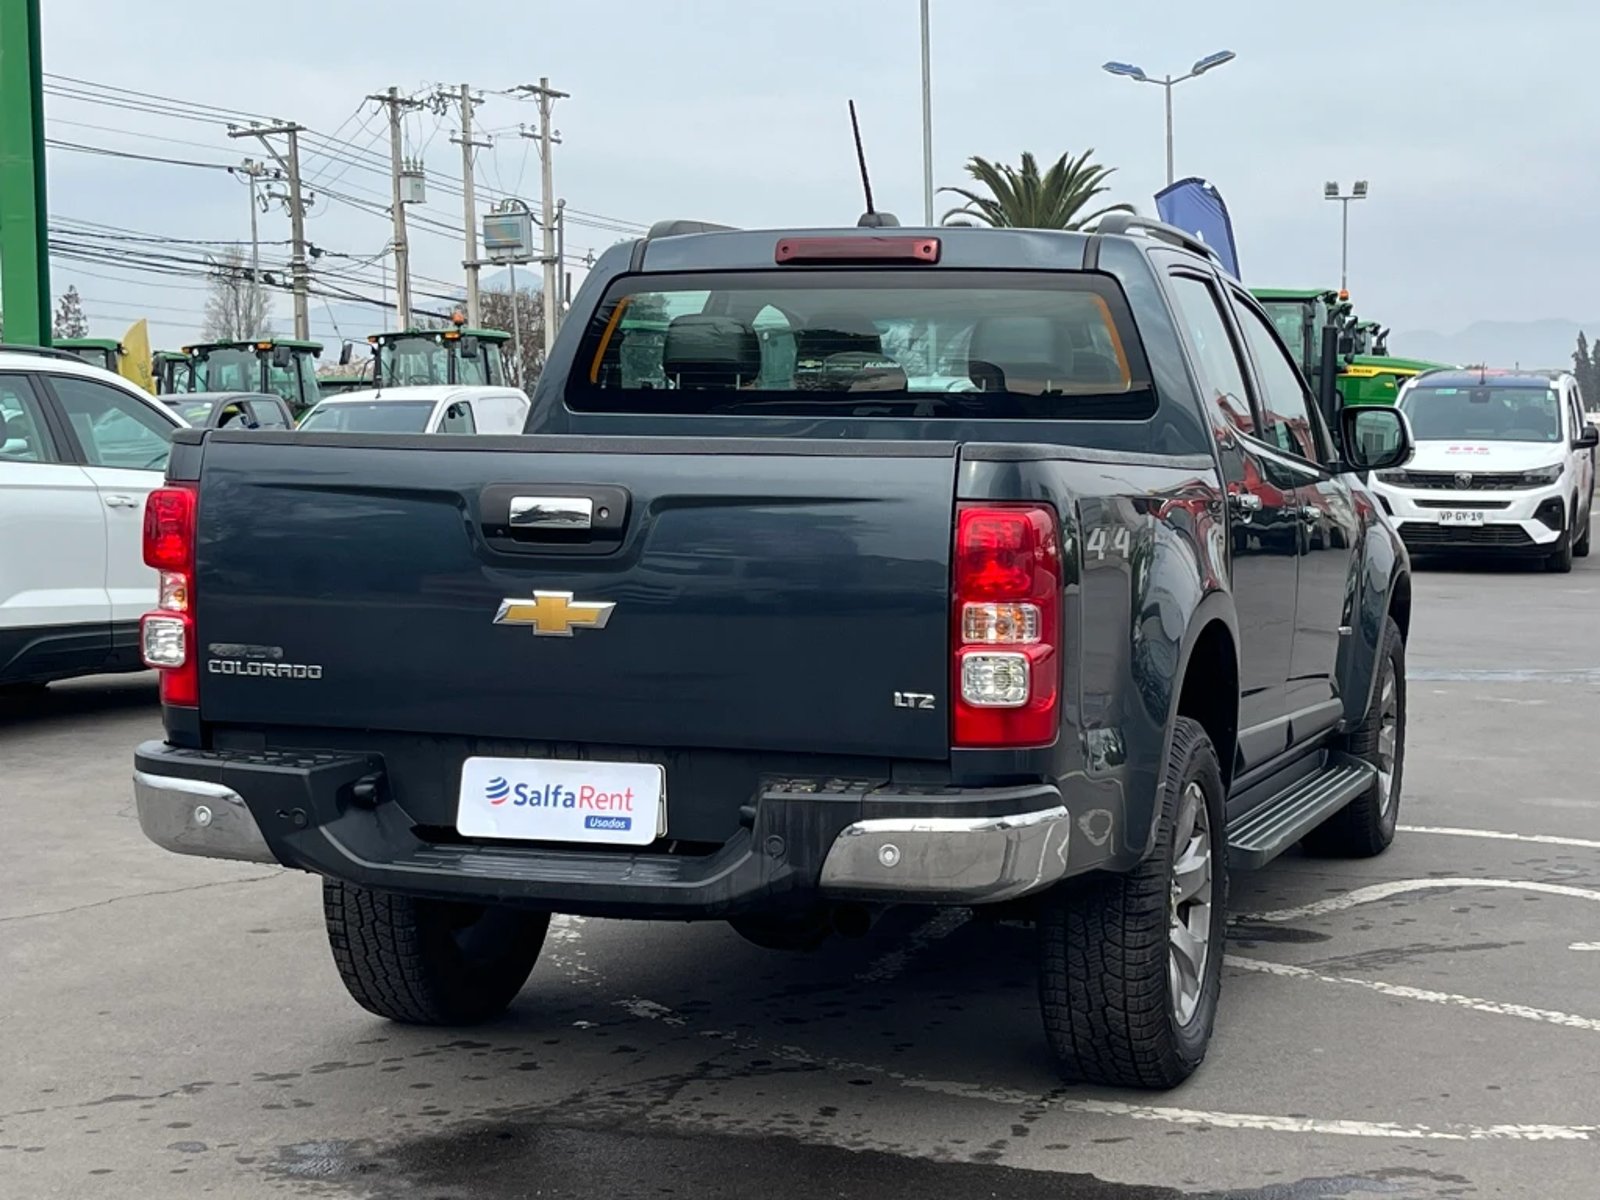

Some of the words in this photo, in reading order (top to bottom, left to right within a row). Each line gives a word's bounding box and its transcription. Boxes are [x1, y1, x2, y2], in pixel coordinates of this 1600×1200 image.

[208, 659, 322, 679] COLORADO
[894, 692, 935, 709] LTZ
[513, 783, 634, 811] SalfaRent
[590, 817, 626, 829] Usados
